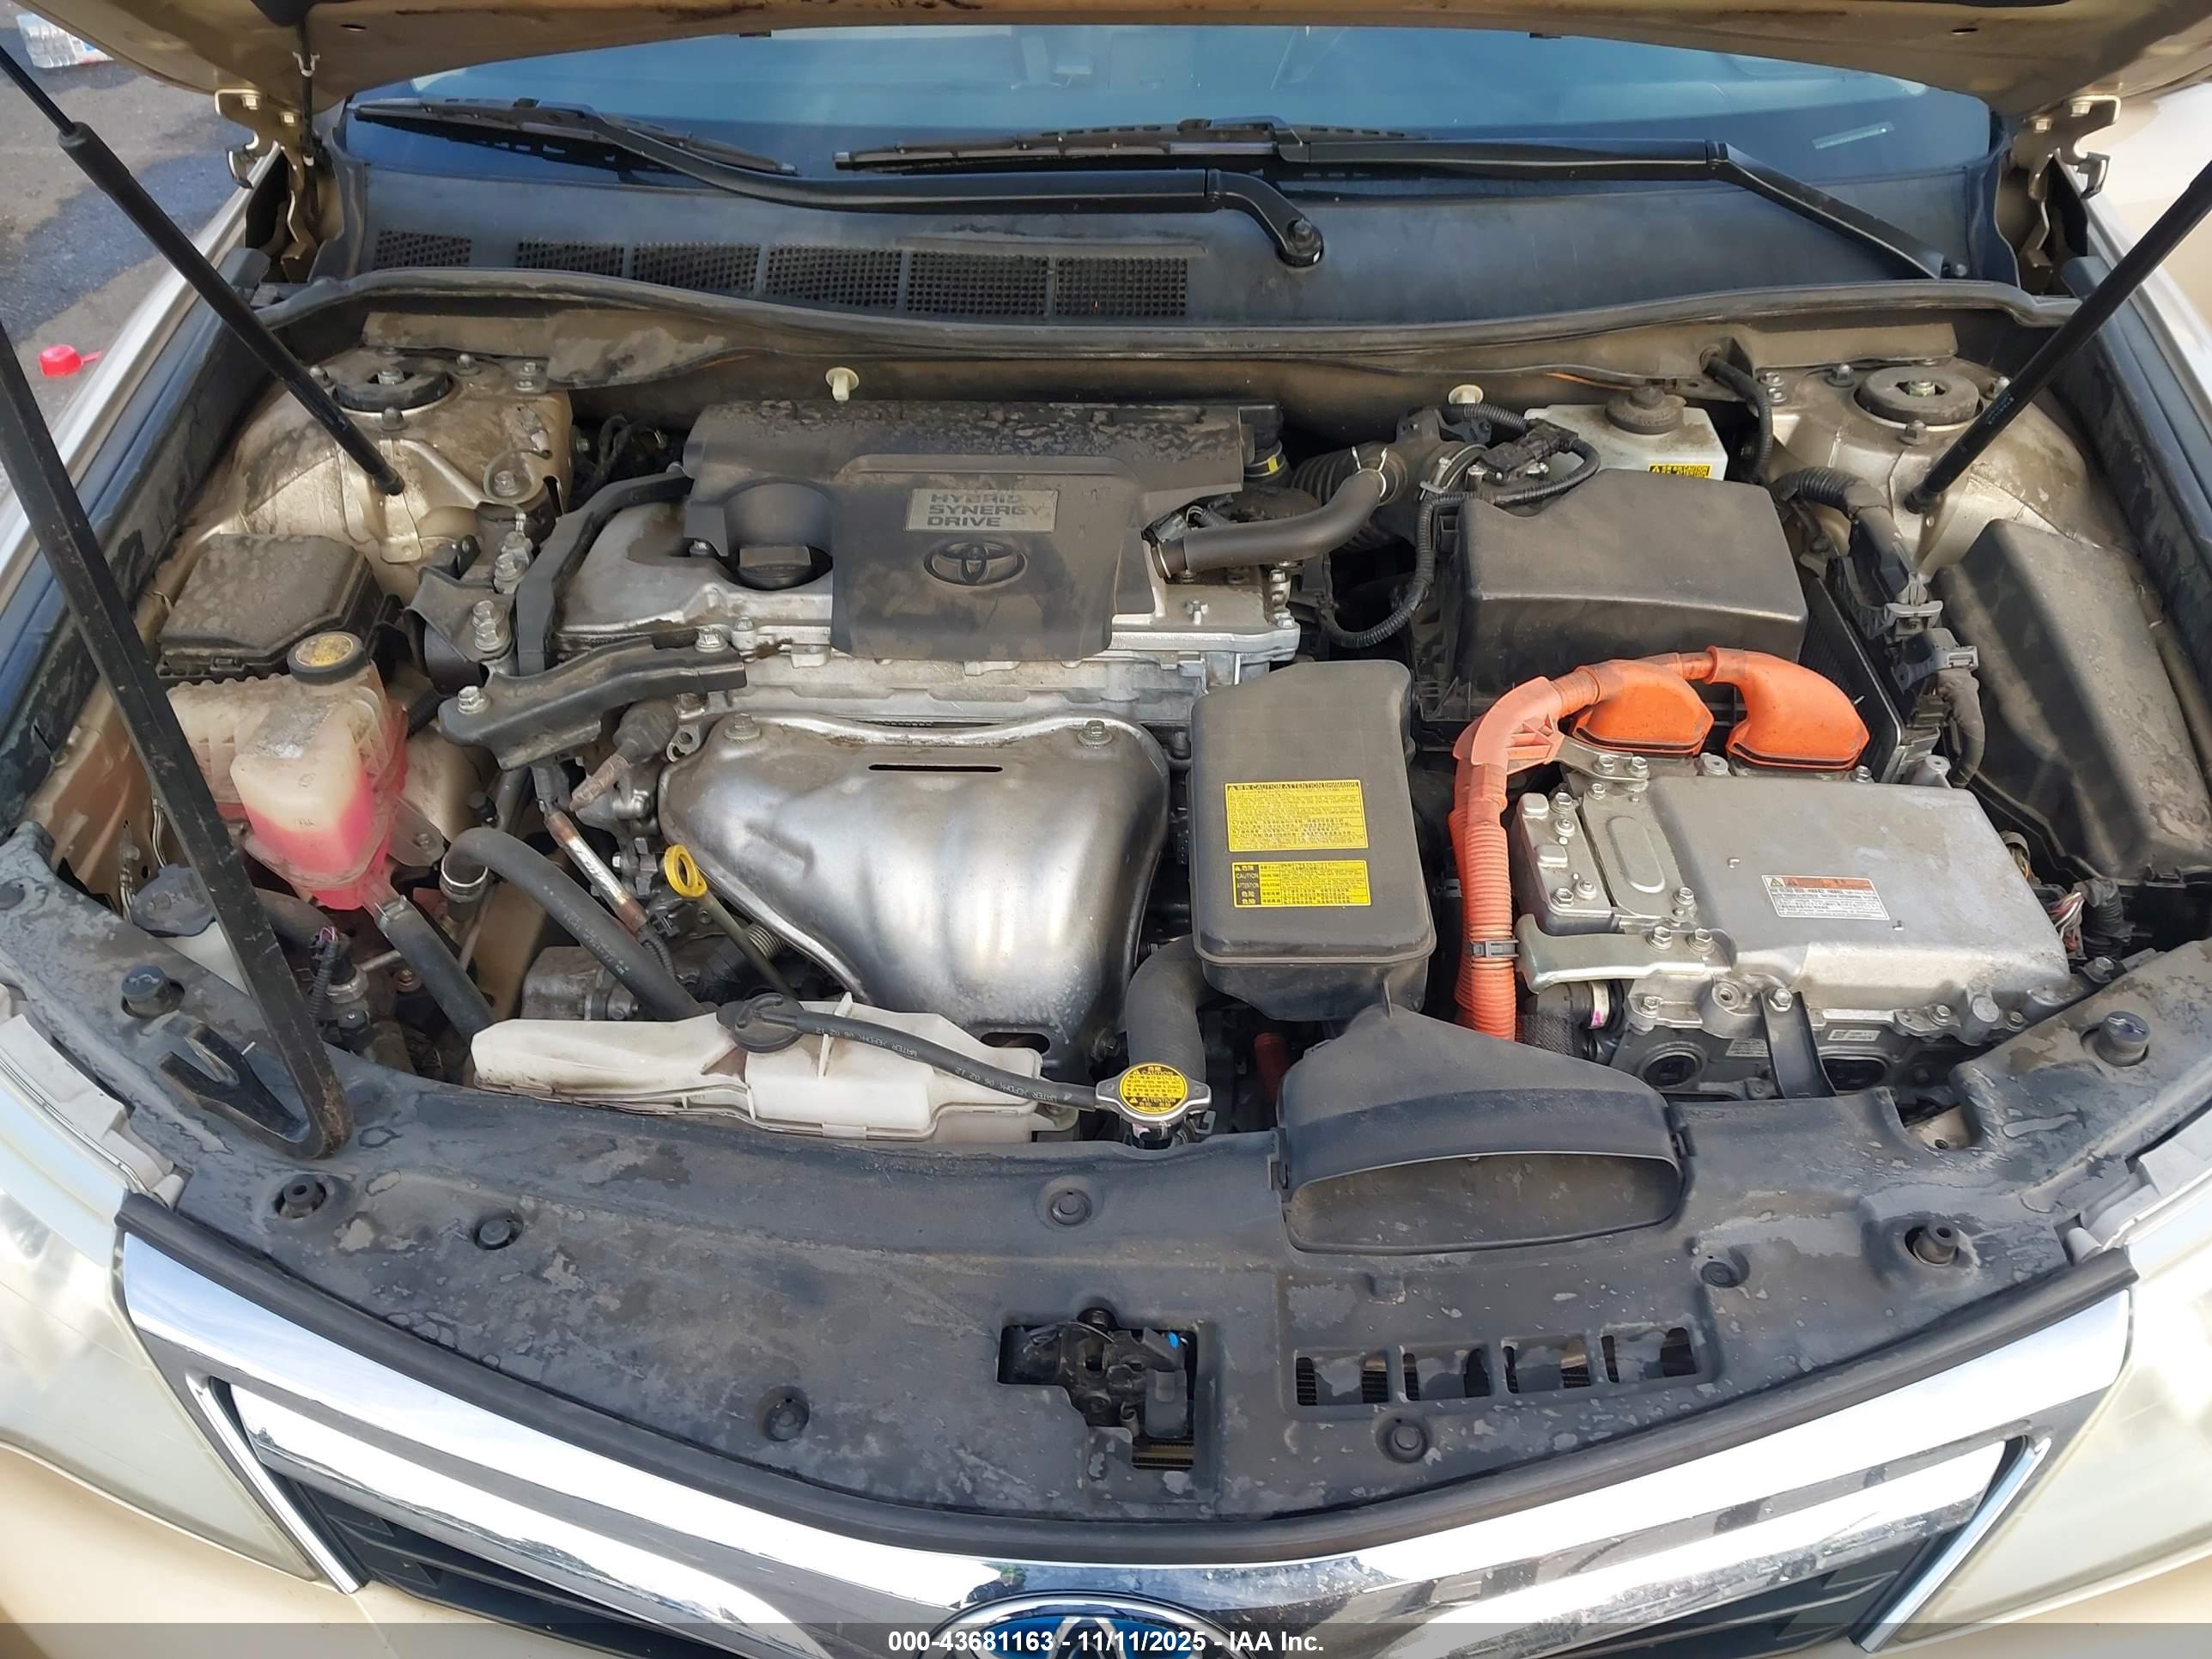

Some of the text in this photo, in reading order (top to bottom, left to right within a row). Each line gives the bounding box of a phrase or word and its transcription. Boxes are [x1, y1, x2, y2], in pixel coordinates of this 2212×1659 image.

[931, 494, 1022, 503] HYBRID
[928, 505, 1044, 515] SYNERGY
[927, 517, 1001, 526] DRIVE
